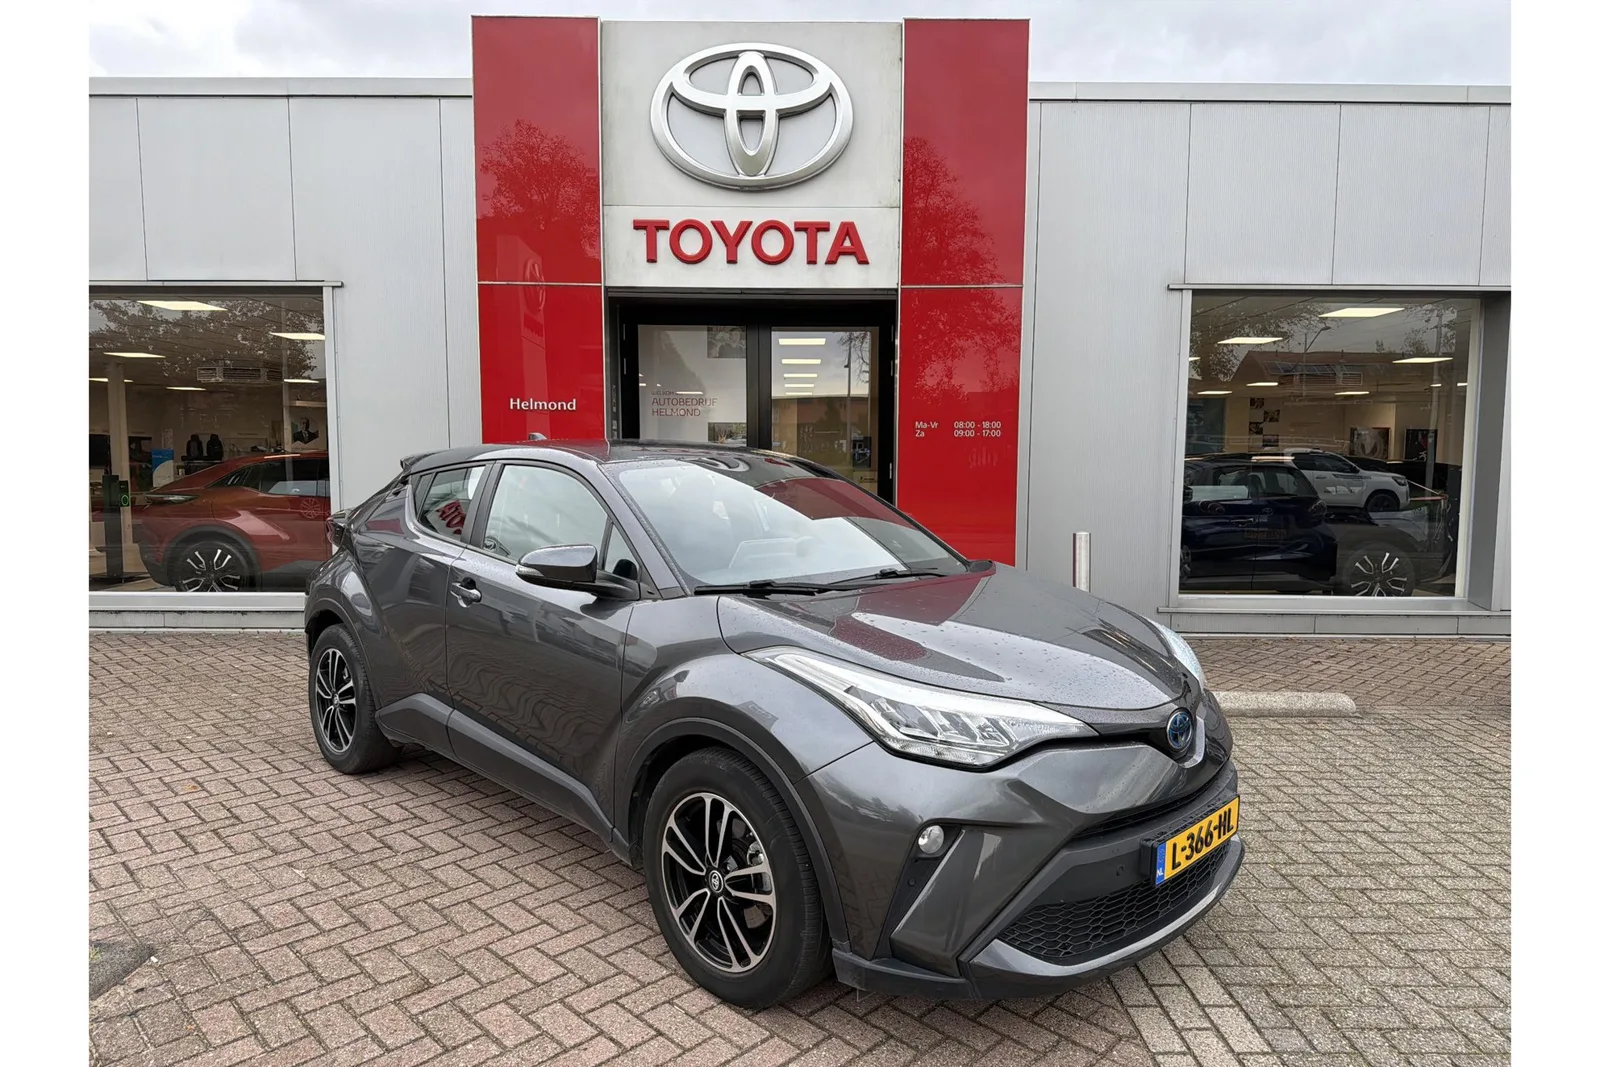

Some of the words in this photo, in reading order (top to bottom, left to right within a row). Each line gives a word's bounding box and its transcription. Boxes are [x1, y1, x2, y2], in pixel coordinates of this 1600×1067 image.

[633, 219, 869, 265] TOYOTA
[509, 398, 577, 411] Helmond
[652, 398, 718, 407] AUTOBEDRIJF
[652, 408, 701, 417] HELMOND
[915, 421, 939, 429] Ma-Vr
[953, 421, 976, 429] 08:00
[982, 421, 1002, 429] 18:00
[953, 429, 975, 437] 09:00
[1171, 808, 1233, 870] L-366-HL
[1156, 867, 1164, 878] NL
